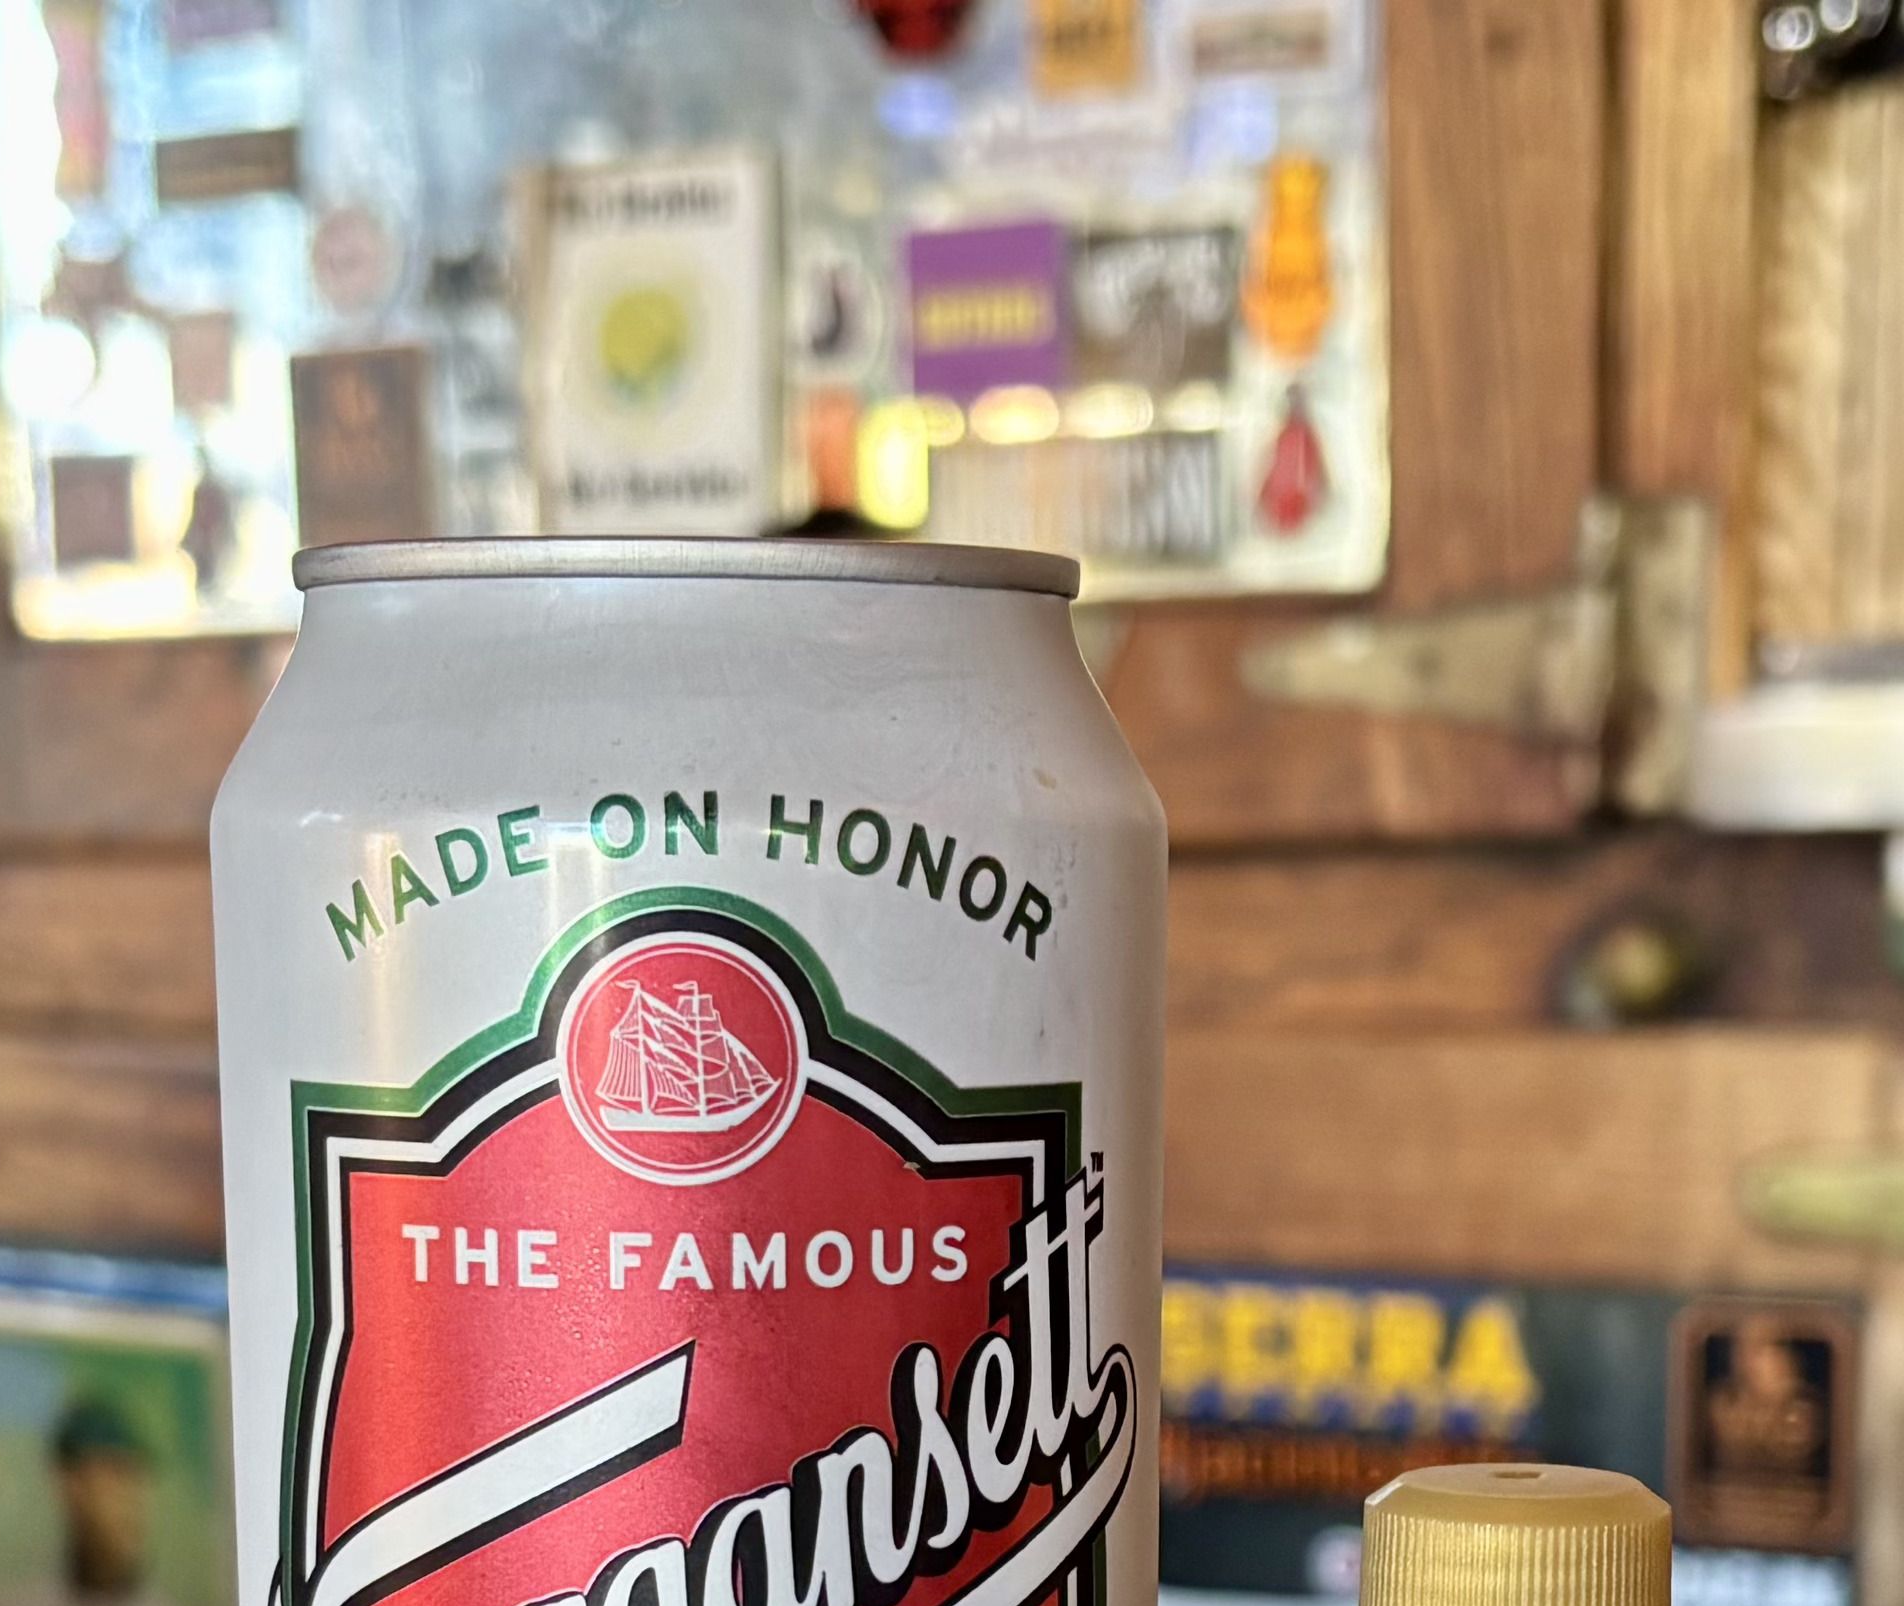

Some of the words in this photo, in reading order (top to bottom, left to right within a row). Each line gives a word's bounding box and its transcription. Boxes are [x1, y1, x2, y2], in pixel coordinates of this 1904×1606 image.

[324, 804, 549, 963] MADE
[588, 790, 720, 860] ON
[765, 793, 1055, 963] HONOR
[402, 1223, 558, 1290] THE
[607, 1224, 970, 1291] FAMOUS
